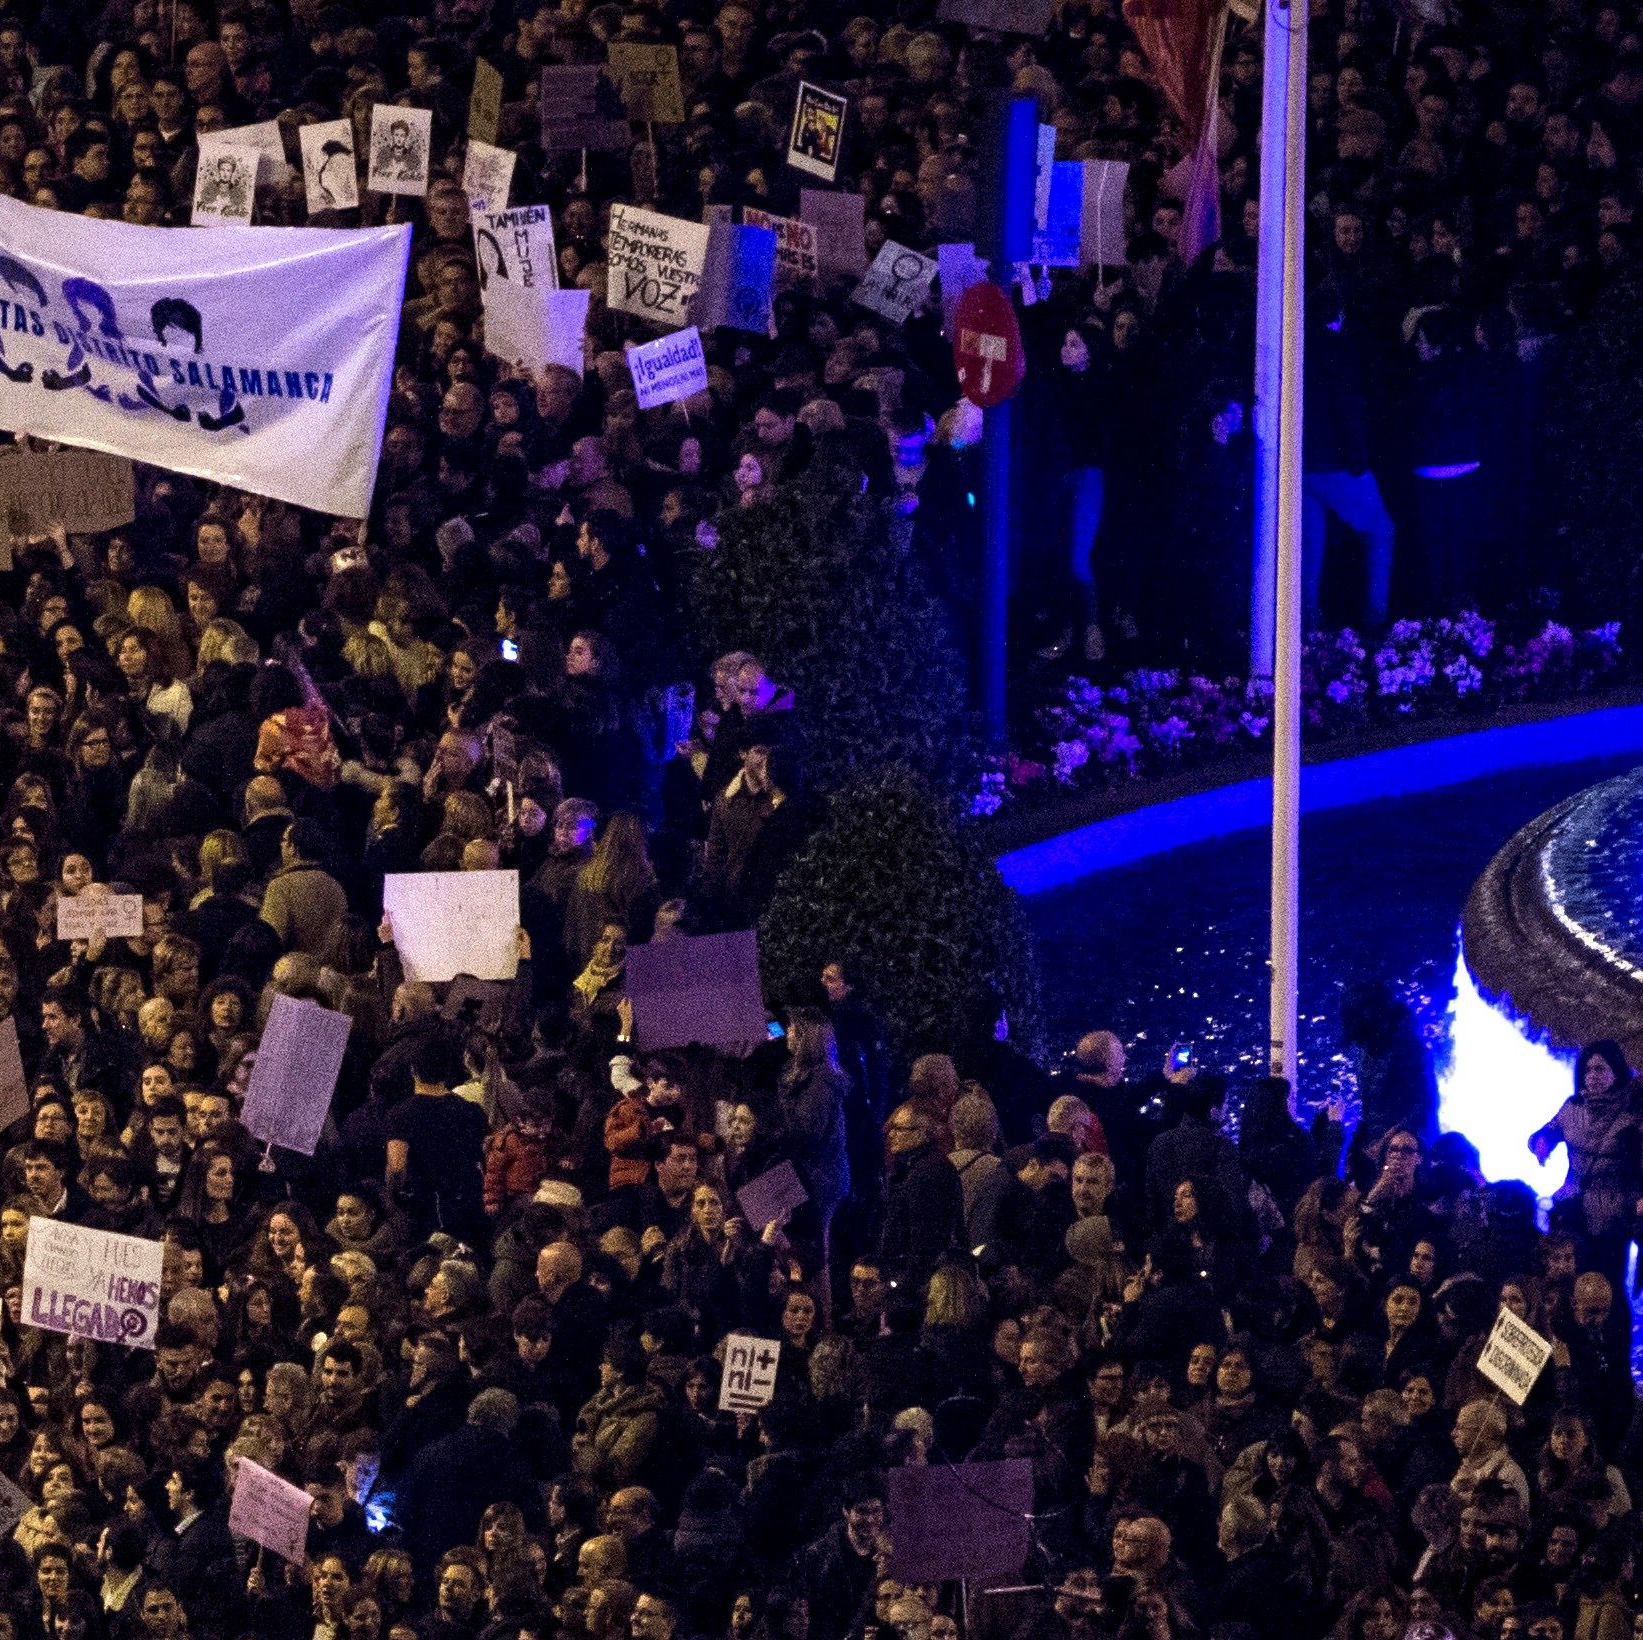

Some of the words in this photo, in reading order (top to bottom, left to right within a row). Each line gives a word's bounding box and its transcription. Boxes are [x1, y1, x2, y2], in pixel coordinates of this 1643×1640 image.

[625, 268, 681, 314] VOZ
[168, 360, 333, 406] SALAMANCA
[638, 342, 701, 382] ¡Igualdad!
